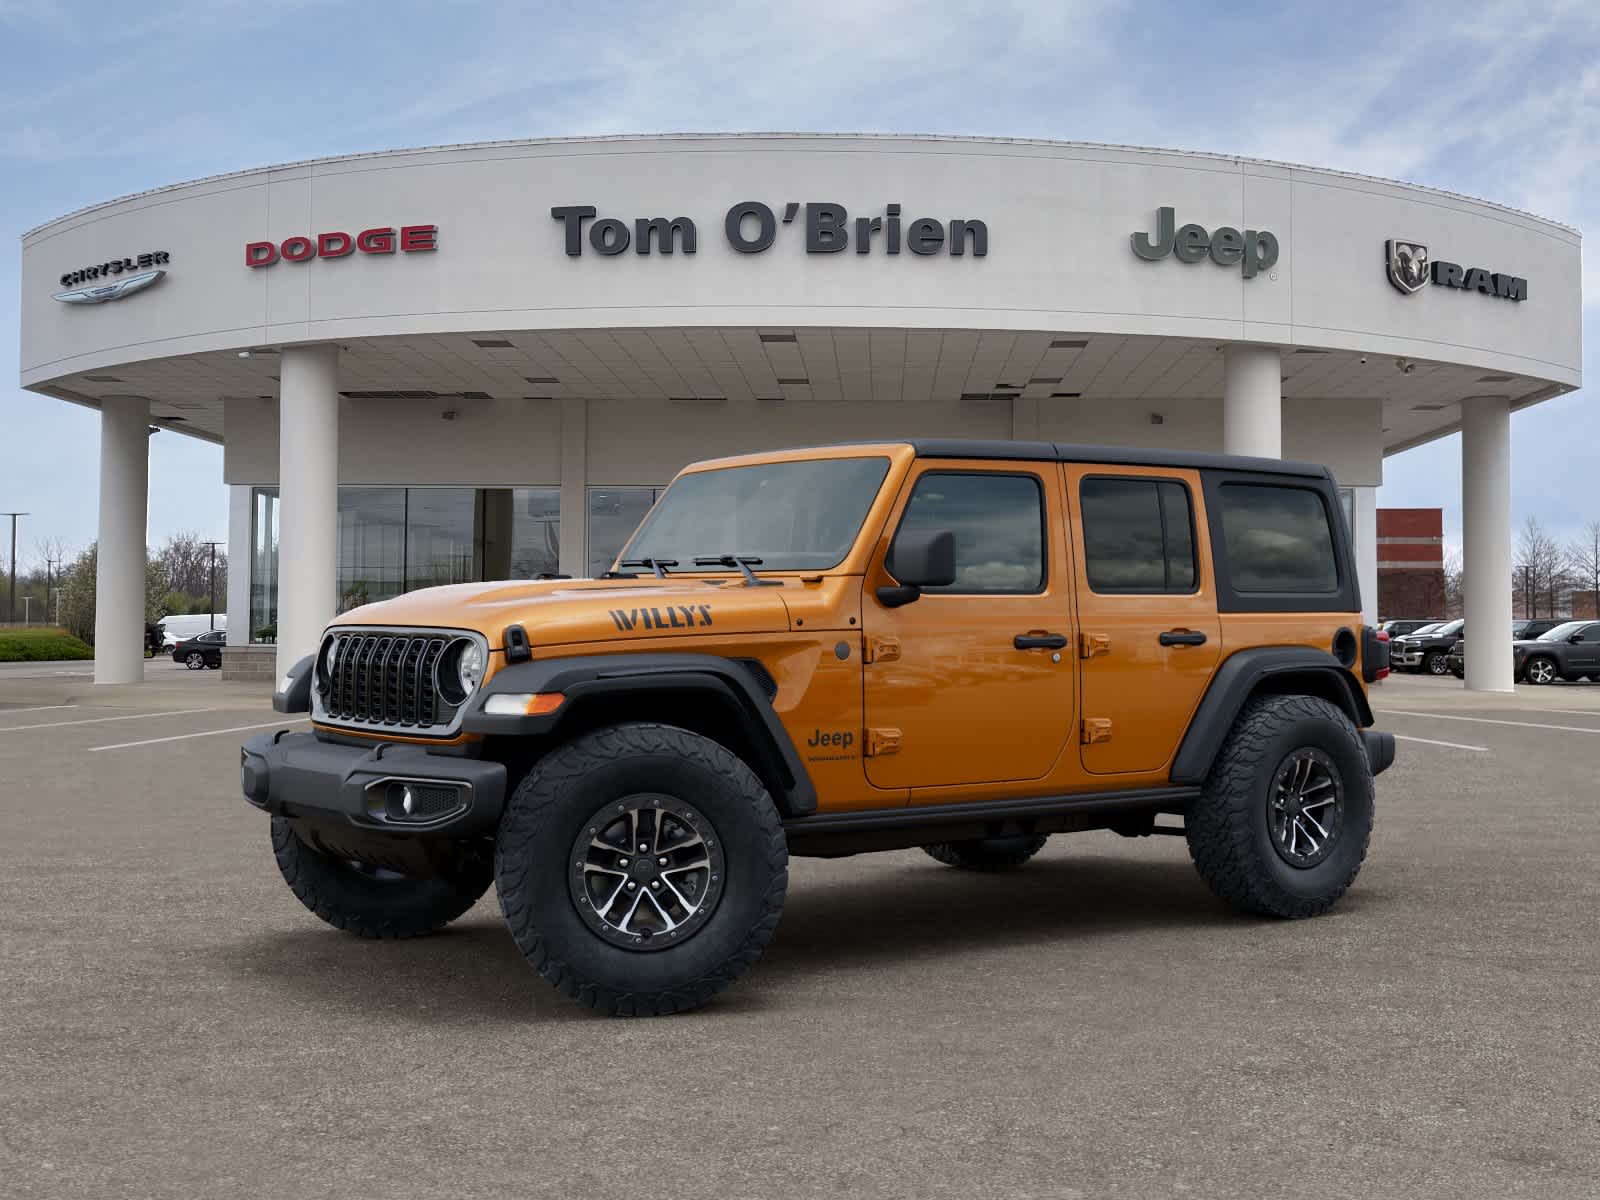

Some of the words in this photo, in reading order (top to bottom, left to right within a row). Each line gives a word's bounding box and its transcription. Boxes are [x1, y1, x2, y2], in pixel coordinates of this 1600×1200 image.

[245, 224, 438, 268] DODGE
[551, 205, 697, 256] Tom
[1130, 206, 1280, 280] Jeep
[60, 249, 170, 287] CHRYSLER
[1431, 260, 1528, 302] RAM
[608, 604, 713, 631] WILLYS
[807, 727, 854, 749] Jeep
